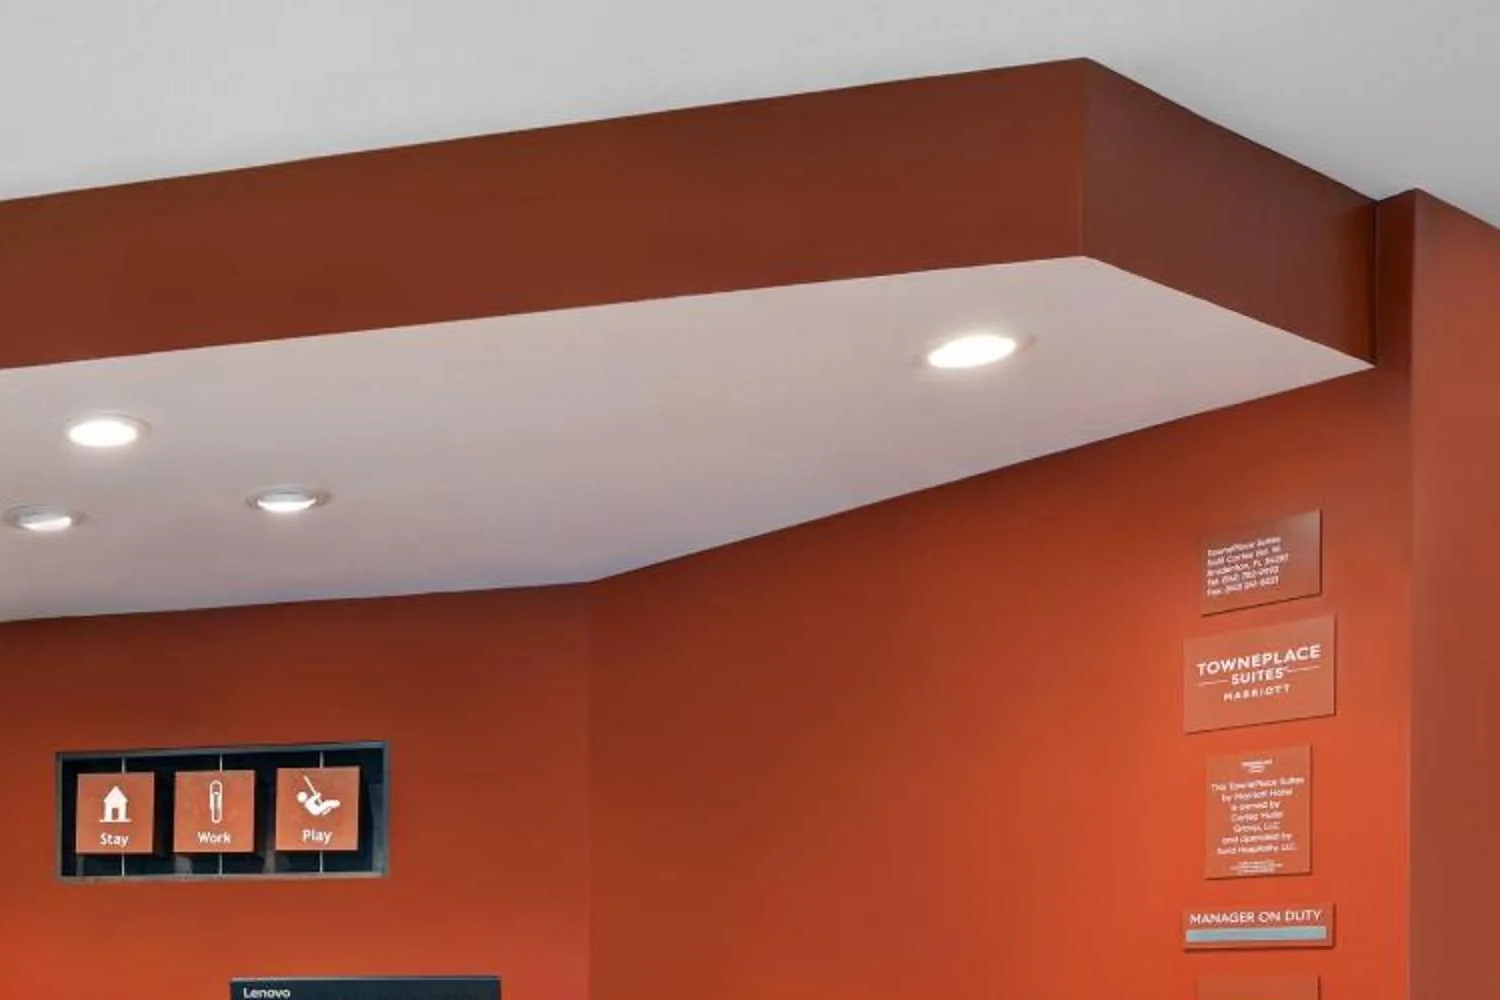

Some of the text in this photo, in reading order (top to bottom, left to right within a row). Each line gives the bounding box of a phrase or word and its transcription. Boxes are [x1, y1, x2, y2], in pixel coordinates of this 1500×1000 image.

[1196, 644, 1321, 677] TOWNEPLACE
[1231, 667, 1284, 685] SUITES
[1223, 683, 1290, 702] MARRIOTT
[100, 833, 129, 846] Stay
[197, 832, 231, 844] Work
[303, 829, 332, 844] Play
[1190, 909, 1322, 925] MANAGER ON DUTY
[243, 987, 291, 999] Lenovo
